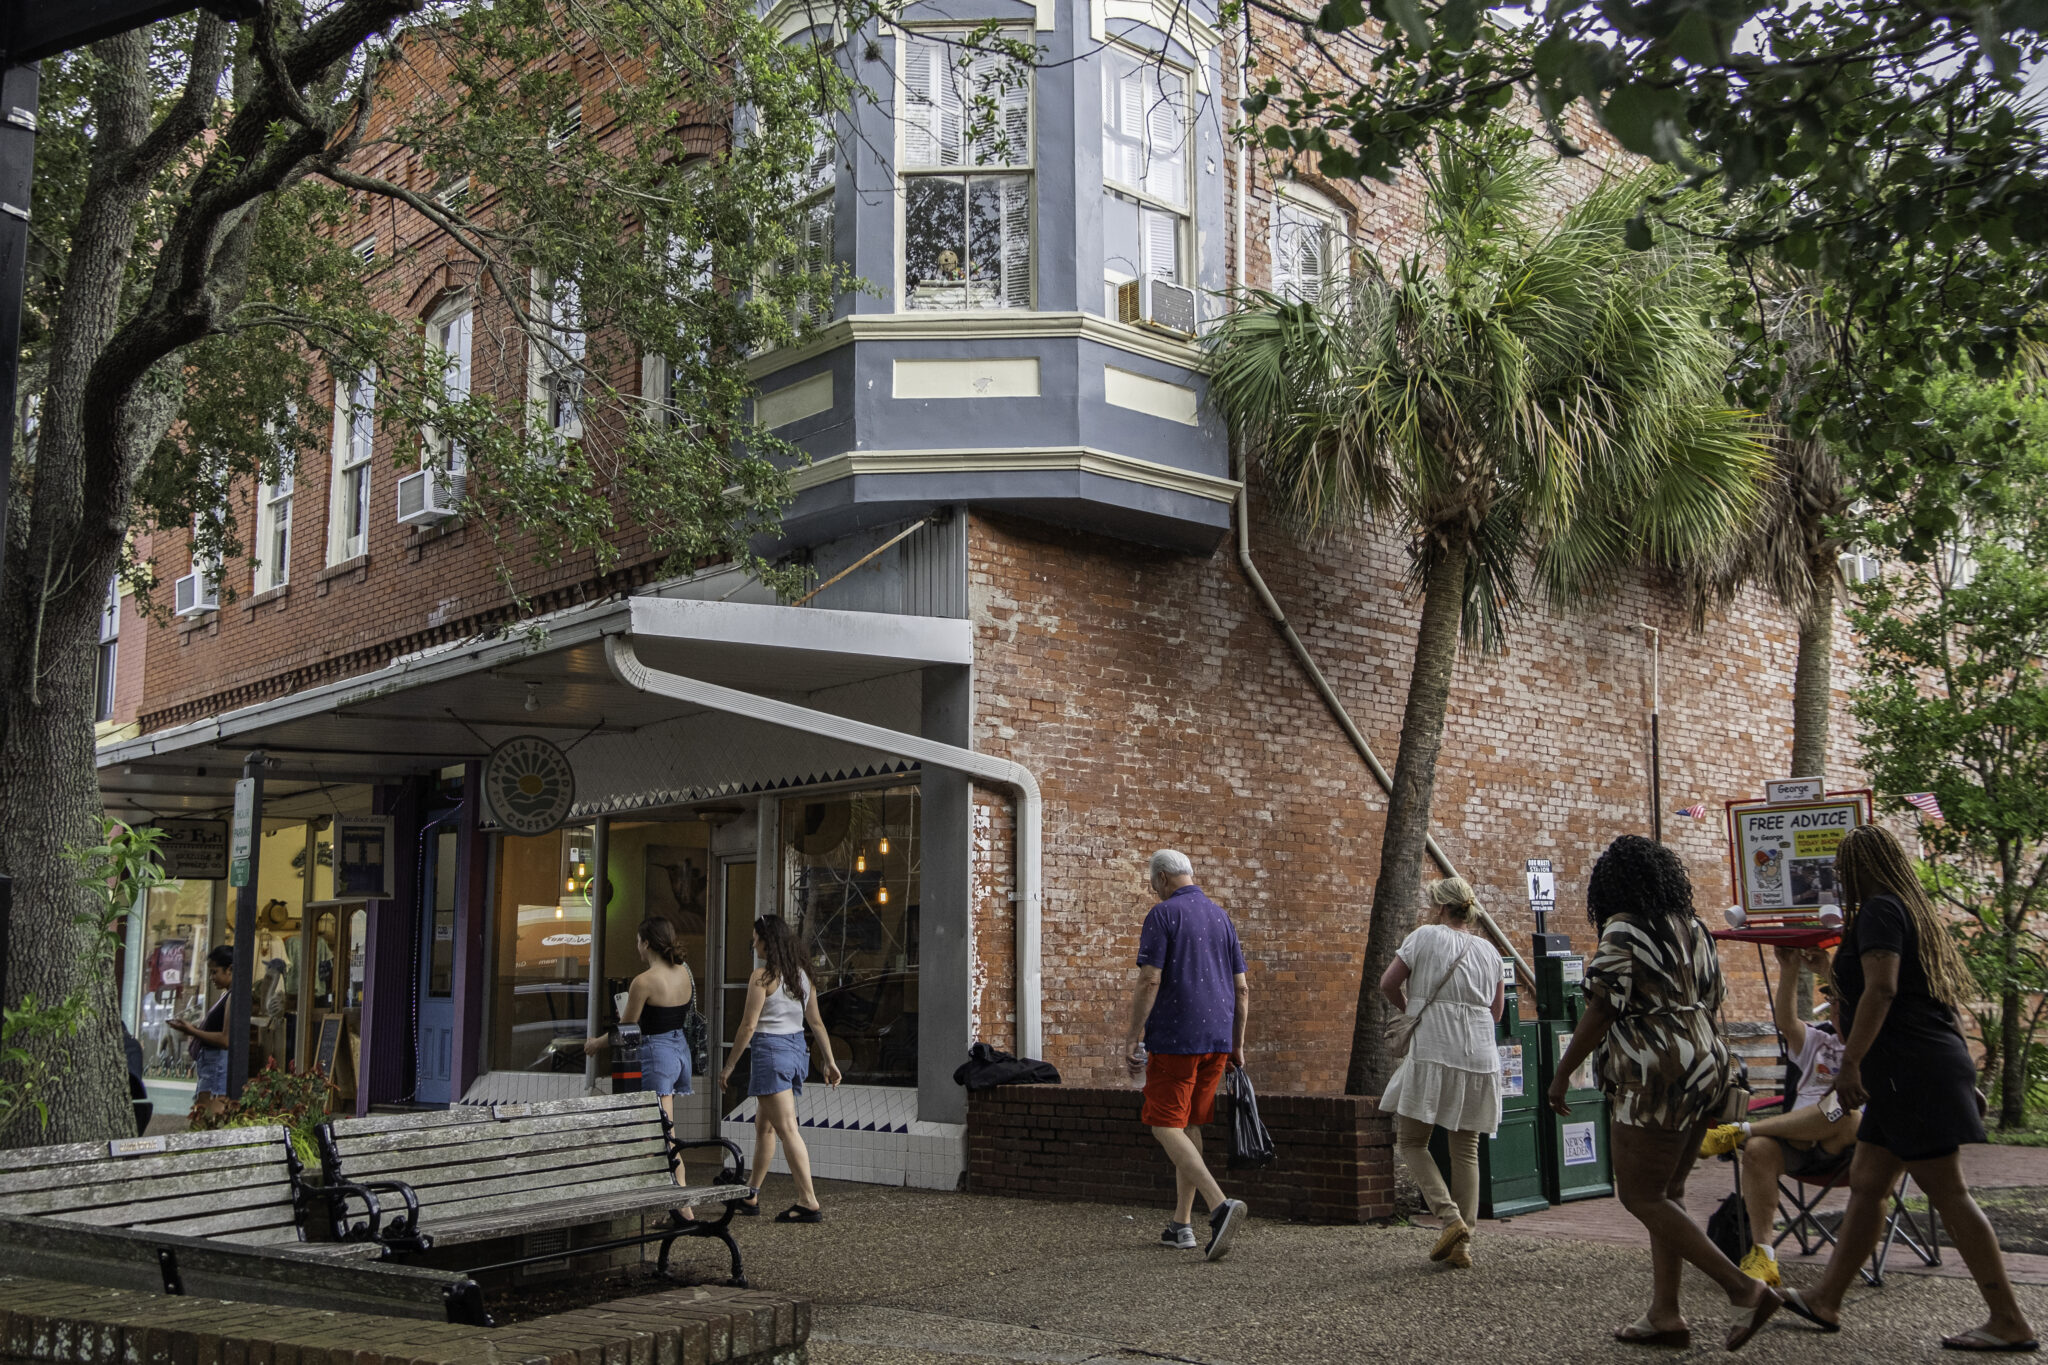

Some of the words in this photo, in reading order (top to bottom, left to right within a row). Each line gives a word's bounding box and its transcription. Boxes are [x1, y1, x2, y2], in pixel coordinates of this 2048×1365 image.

[490, 741, 528, 785] AMELIA
[533, 741, 570, 788] ISLAND
[1777, 784, 1809, 795] George
[506, 812, 557, 830] COFFEE
[1749, 815, 1785, 832] FREE
[1790, 810, 1848, 829] ADVICE
[232, 826, 250, 838] PARKING
[1750, 835, 1759, 843] By
[1761, 833, 1784, 843] George
[1565, 1136, 1584, 1148] NEWS
